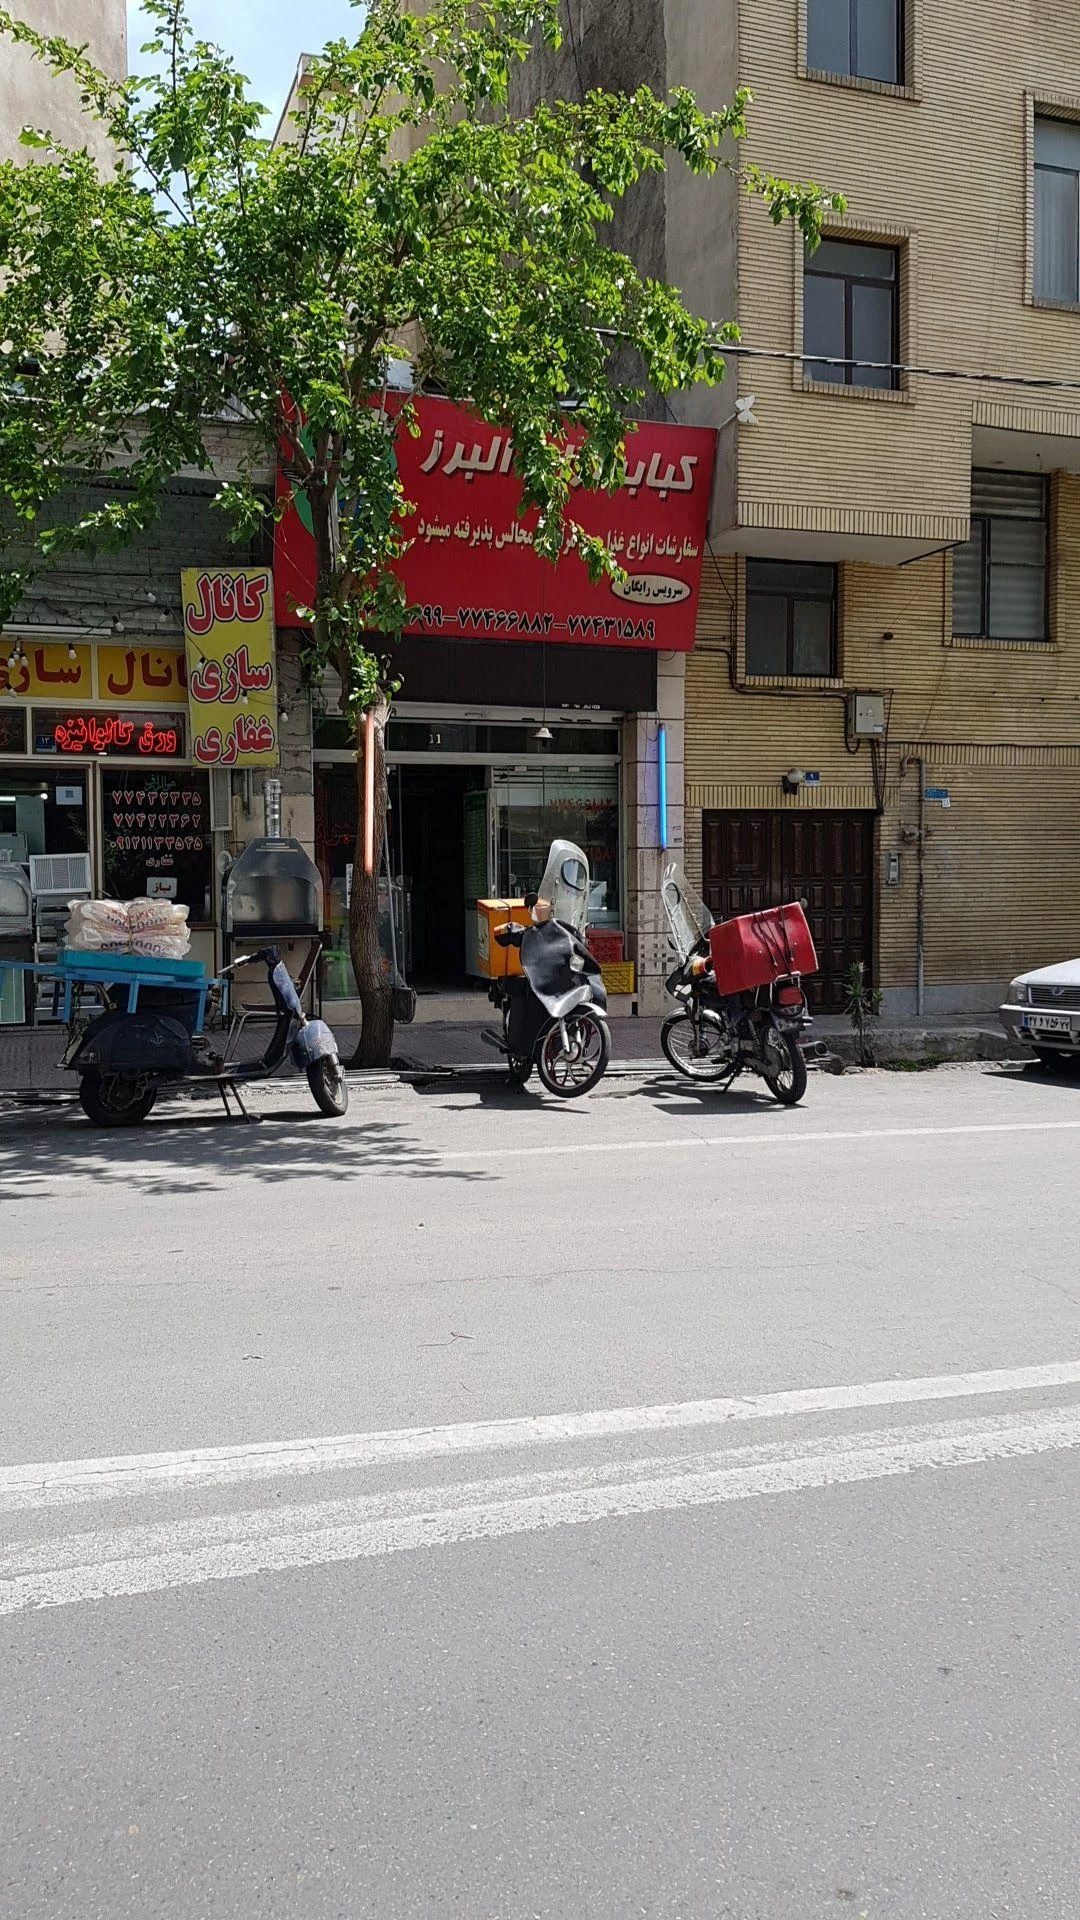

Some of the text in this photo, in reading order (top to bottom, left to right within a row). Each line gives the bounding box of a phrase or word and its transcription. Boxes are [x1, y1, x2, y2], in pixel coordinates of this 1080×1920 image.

[419, 429, 513, 480] البرز
[417, 515, 451, 544] میشود
[453, 515, 493, 549] پذیرفته
[495, 520, 534, 551] مجالس
[606, 529, 626, 552] غذا
[625, 530, 655, 561] انواع
[655, 532, 699, 563] سفارشات
[623, 578, 684, 598] سرویس رایگان
[186, 573, 268, 635] کانال
[107, 650, 187, 695] انال
[191, 644, 273, 704] سازی
[138, 721, 177, 752] ورق
[194, 713, 275, 765] غفاری
[112, 790, 202, 806] ۷۷۴۳۲۳۳۵
[112, 813, 201, 828] ۷۷۴۲۲۳۶۲
[109, 836, 203, 851] ۰۹۱۲۱۱۳۳۵۴۵
[145, 854, 174, 868] غفاری
[152, 882, 172, 894] باز
